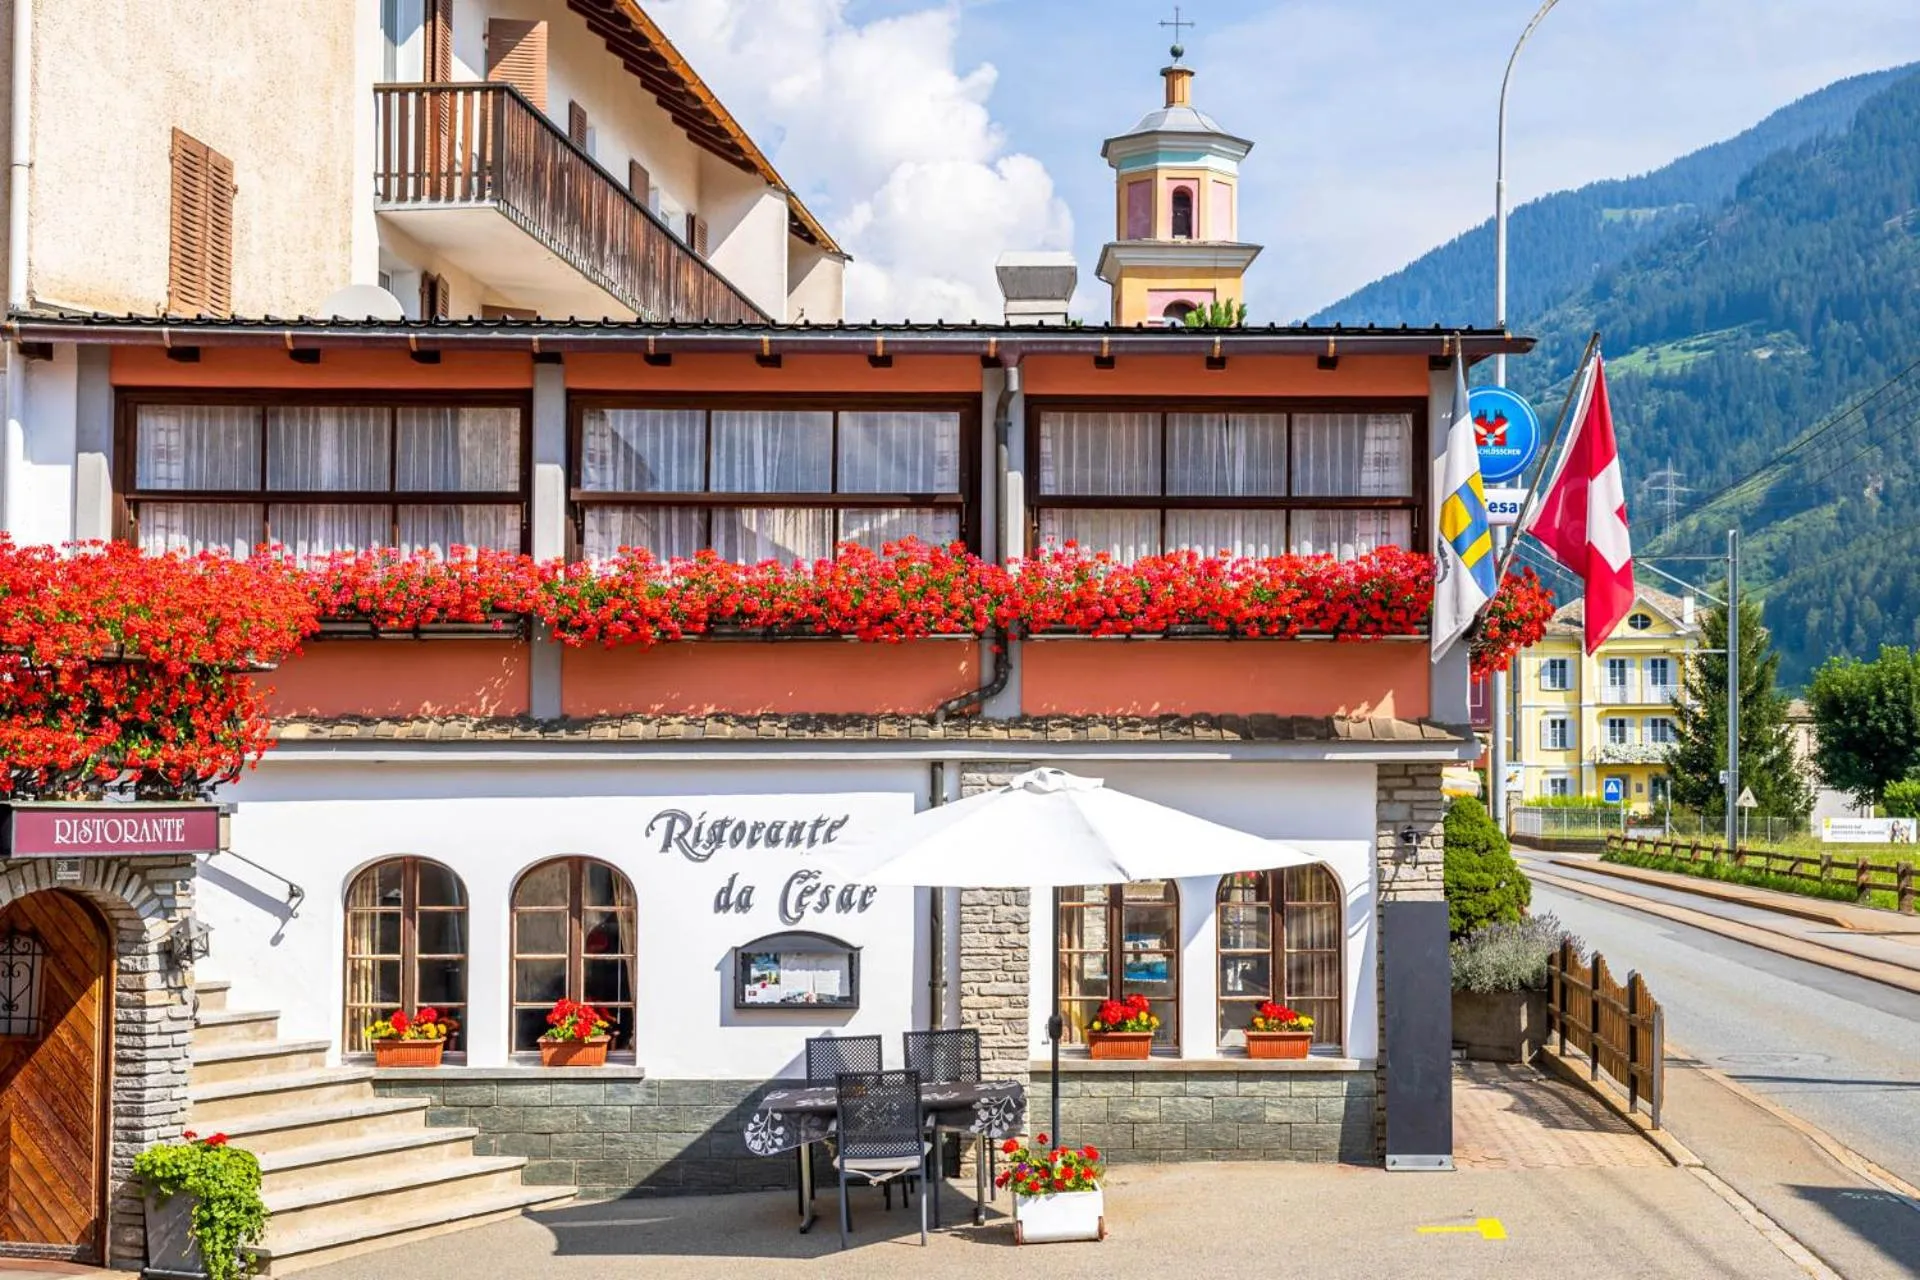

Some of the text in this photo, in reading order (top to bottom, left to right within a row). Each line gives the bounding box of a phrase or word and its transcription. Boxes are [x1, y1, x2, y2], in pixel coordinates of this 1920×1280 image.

[54, 818, 185, 844] RISTORANTE
[645, 808, 850, 863] Ristorante
[713, 869, 877, 926] da Cesar
